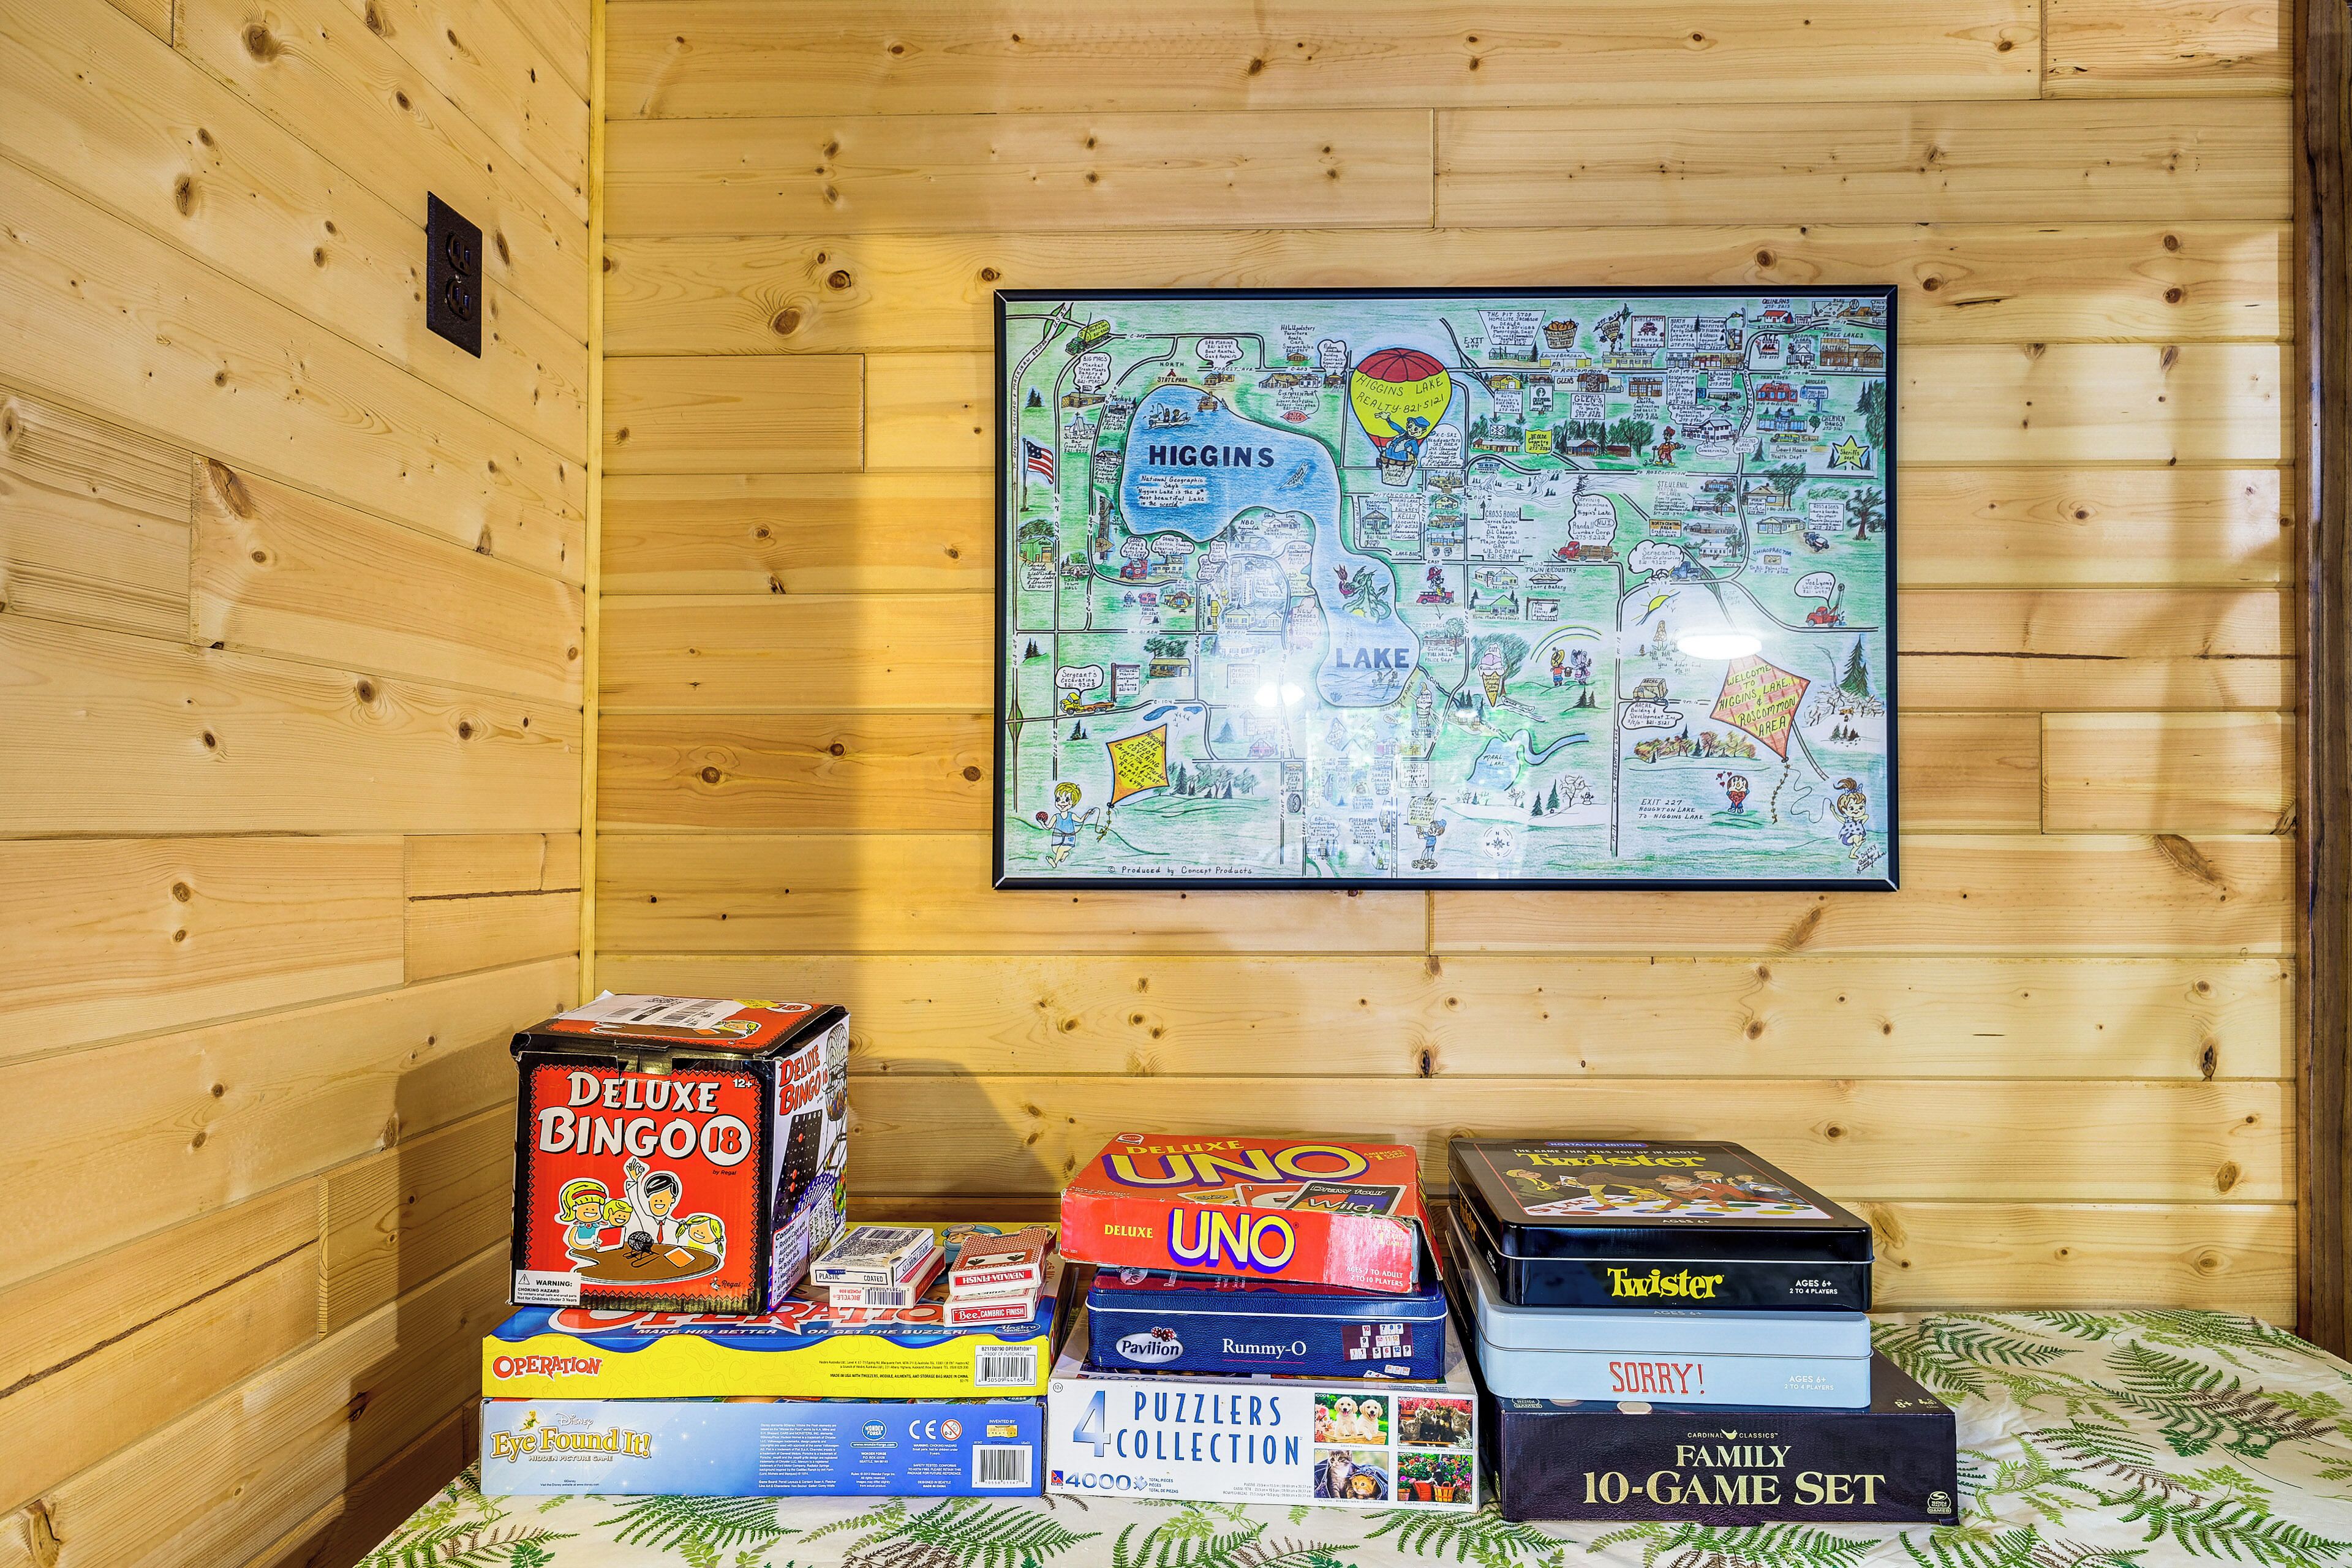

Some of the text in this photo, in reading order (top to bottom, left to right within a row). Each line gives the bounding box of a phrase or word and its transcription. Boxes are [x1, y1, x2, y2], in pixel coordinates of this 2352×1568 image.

[1356, 375, 1443, 396] HIGGINS LAKE
[1149, 445, 1274, 467] HIGGINS
[1336, 648, 1409, 668] LAKE
[1062, 670, 1096, 679] Sergeant's
[1727, 665, 1771, 685] WELCOME
[1719, 690, 1756, 710] HIGGINS
[1738, 696, 1795, 726] ROSCOMMON
[1758, 716, 1786, 736] AREA
[1168, 867, 1174, 876] by
[779, 1044, 820, 1087] DELUXE
[567, 1071, 752, 1114] DELUXE 12+
[779, 1068, 827, 1115] BINGO 18
[538, 1106, 742, 1158] BINGO 18
[1127, 1140, 1244, 1154] DELUXE
[1103, 1145, 1370, 1188] UNO
[1516, 1153, 1706, 1167] Twister
[1310, 1185, 1386, 1196] Draw four
[1306, 1197, 1374, 1213] Wild
[1104, 1224, 1153, 1238] DELUXE
[1168, 1208, 1295, 1269] UNO
[1376, 1278, 1403, 1286] PLAYERS
[1607, 1267, 1722, 1298] Twister
[1122, 1340, 1180, 1357] Pavilion
[1222, 1339, 1306, 1359] Rummy-O
[493, 1355, 602, 1381] OPERATION
[1609, 1362, 1705, 1395] SORRY!
[556, 1412, 593, 1429] Disney
[909, 1420, 937, 1439] CE
[1072, 1390, 1281, 1458] 4 PUZZLERS
[491, 1428, 650, 1462] Eye Found It!
[1117, 1428, 1298, 1466] COLLECTION
[1676, 1445, 1792, 1468] FAMILY
[1065, 1472, 1131, 1491] 4000
[1583, 1469, 1885, 1506] 10-GAME SET
